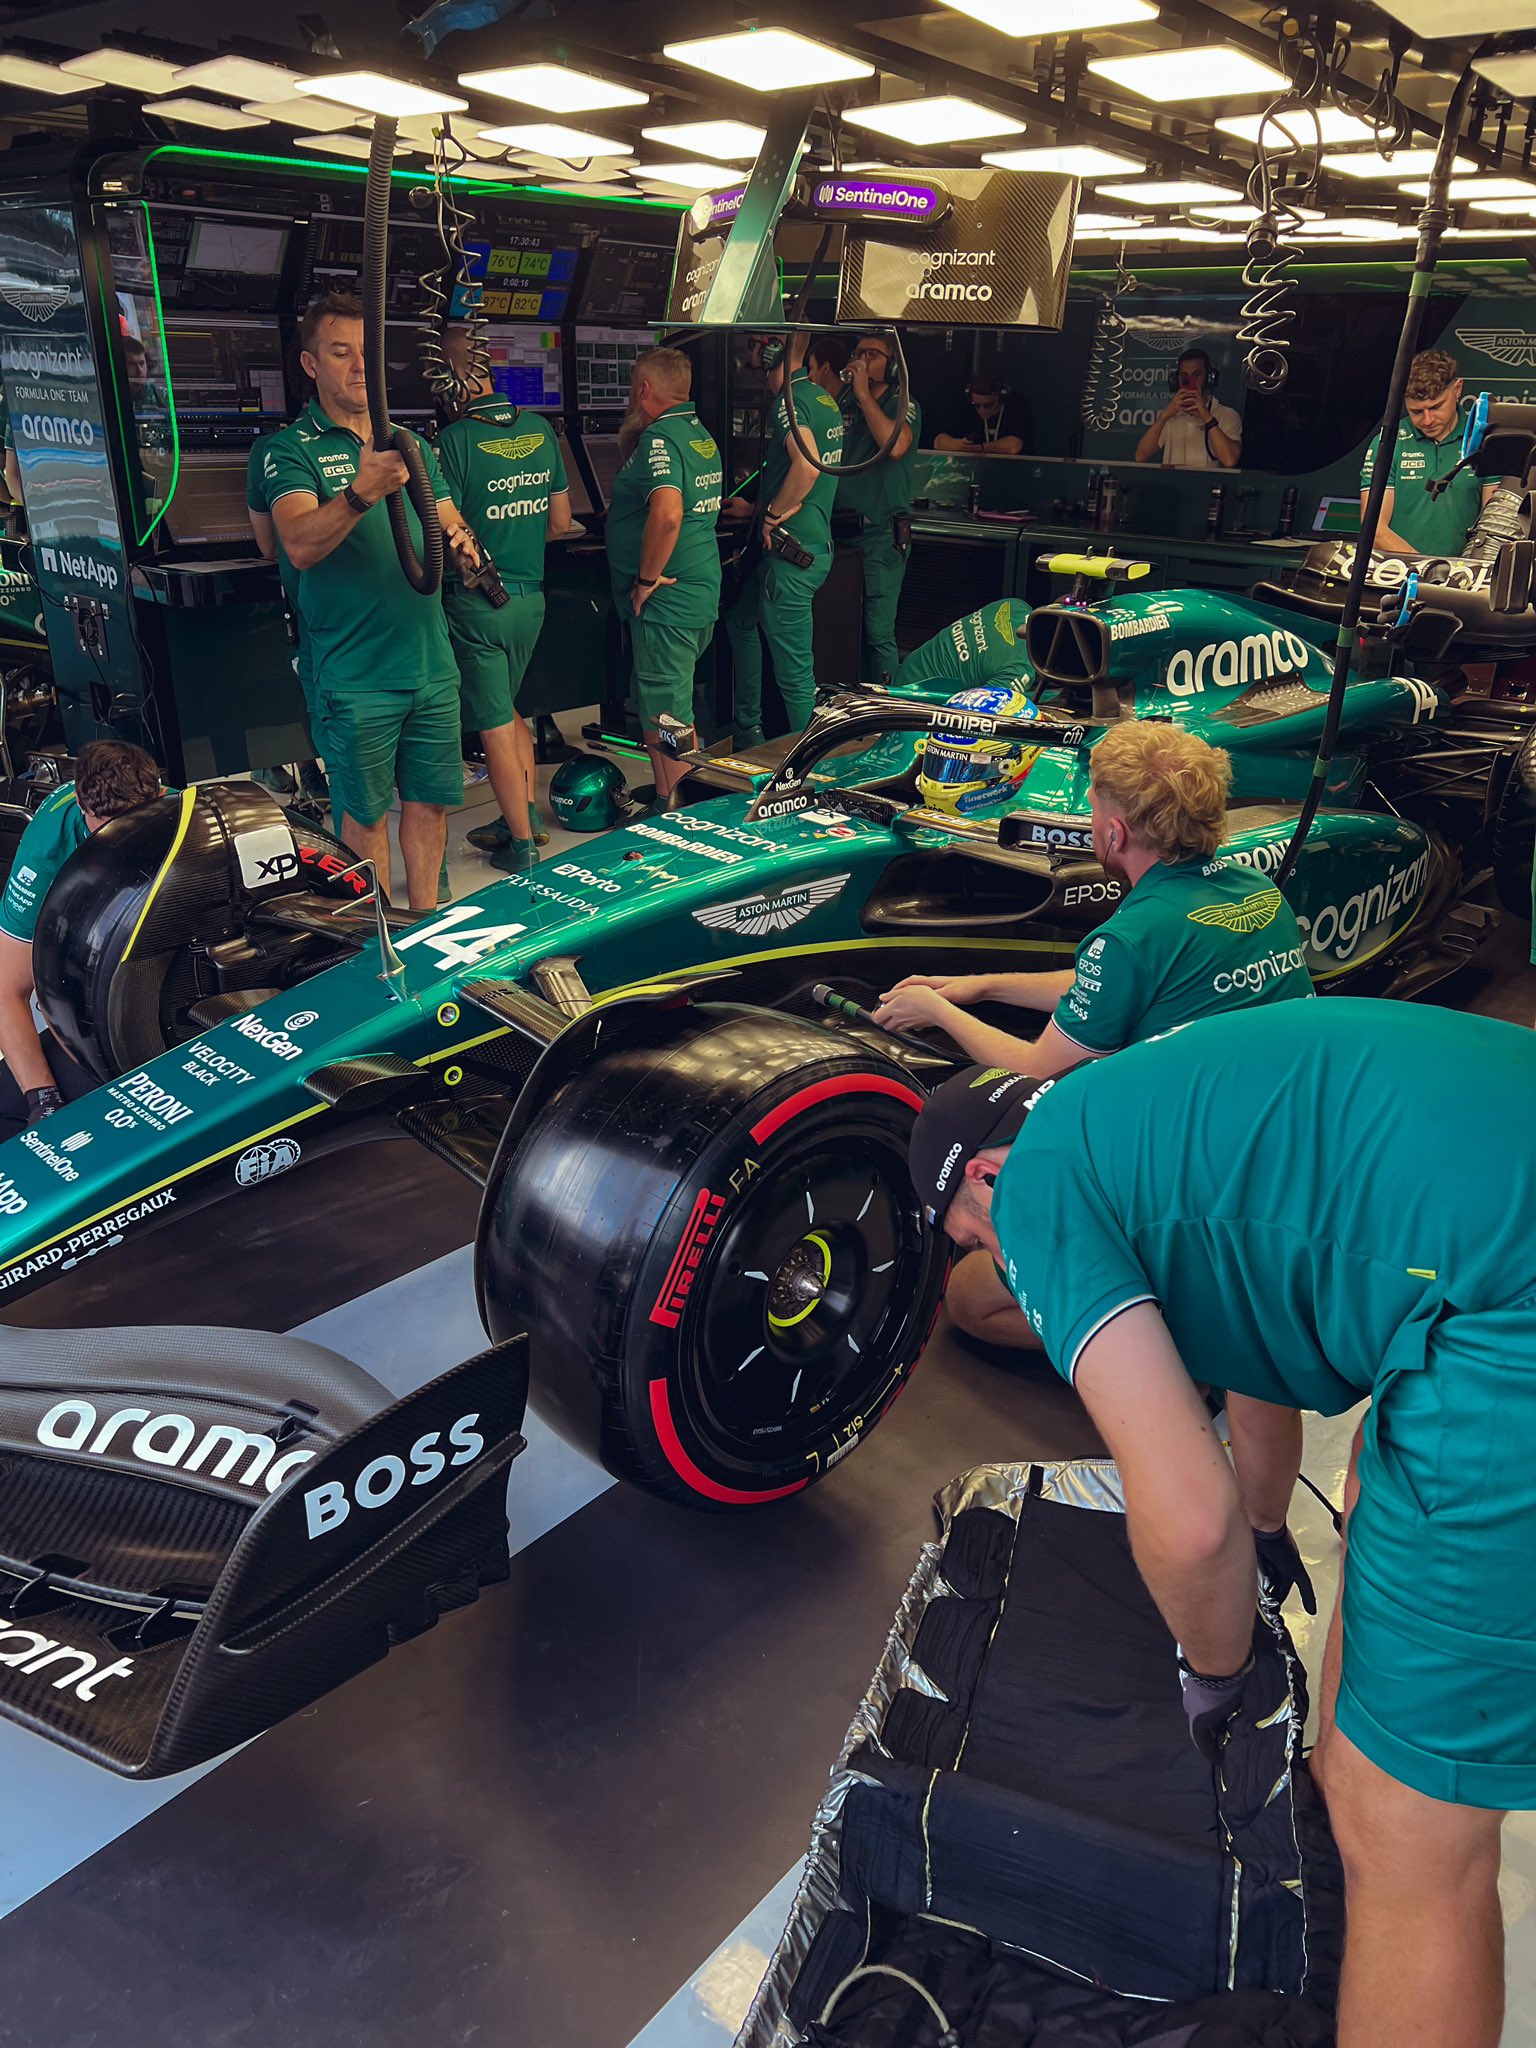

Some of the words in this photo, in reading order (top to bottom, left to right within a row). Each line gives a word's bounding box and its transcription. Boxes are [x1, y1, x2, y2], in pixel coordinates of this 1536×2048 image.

[835, 187, 928, 208] SentinelOne
[509, 236, 541, 247] 17:30:43
[491, 254, 517, 269] 76°C
[523, 257, 548, 271] 74°C
[908, 249, 996, 270] cognizant
[503, 278, 529, 288] 0:00:16
[906, 283, 993, 301] aramco
[514, 297, 538, 310] 82°C
[10, 345, 83, 379] cognizant
[15, 387, 49, 400] FORMULA
[68, 390, 89, 403] TEAM
[22, 413, 94, 446] aramco
[494, 413, 512, 421] BOSS
[318, 453, 349, 463] aramco
[325, 465, 354, 477] JCB
[1401, 460, 1425, 468] JCB
[487, 469, 551, 493] cognizant
[59, 551, 118, 589] NetApp
[1110, 614, 1171, 641] BOMBARDIER
[1166, 630, 1309, 697] aramco
[1391, 676, 1439, 725] 14
[940, 748, 969, 761] MARTIN
[775, 778, 802, 792] NexGen
[757, 795, 807, 818] aramco
[624, 822, 744, 864] BOMBARDIER
[660, 811, 789, 853] cognizant
[569, 868, 622, 893] Porto
[1201, 859, 1228, 877] BOSS
[501, 873, 531, 888] FLY
[537, 886, 600, 916] SAUDIA
[738, 903, 770, 918] ASTON
[771, 893, 807, 910] MARTIN
[1224, 906, 1244, 918] ASTON
[1244, 899, 1267, 914] MARTIN
[392, 905, 529, 971] 14
[1068, 998, 1089, 1021] BOSS
[230, 1013, 304, 1061] NexGen
[181, 1060, 221, 1087] BLACK
[187, 1041, 256, 1085] VELOCITY
[106, 1087, 133, 1109] NASTRO
[131, 1105, 167, 1131] AZZURRO
[118, 1071, 194, 1125] PERONI
[20, 1130, 80, 1182] SentinelOne
[936, 1142, 963, 1192] aramco
[728, 1157, 761, 1195] FA
[0, 1187, 177, 1290] GIRARD-PERREGAUX
[649, 1187, 727, 1329] PIRELLI
[303, 1413, 485, 1540] BOSS
[0, 1618, 135, 1702] ant
